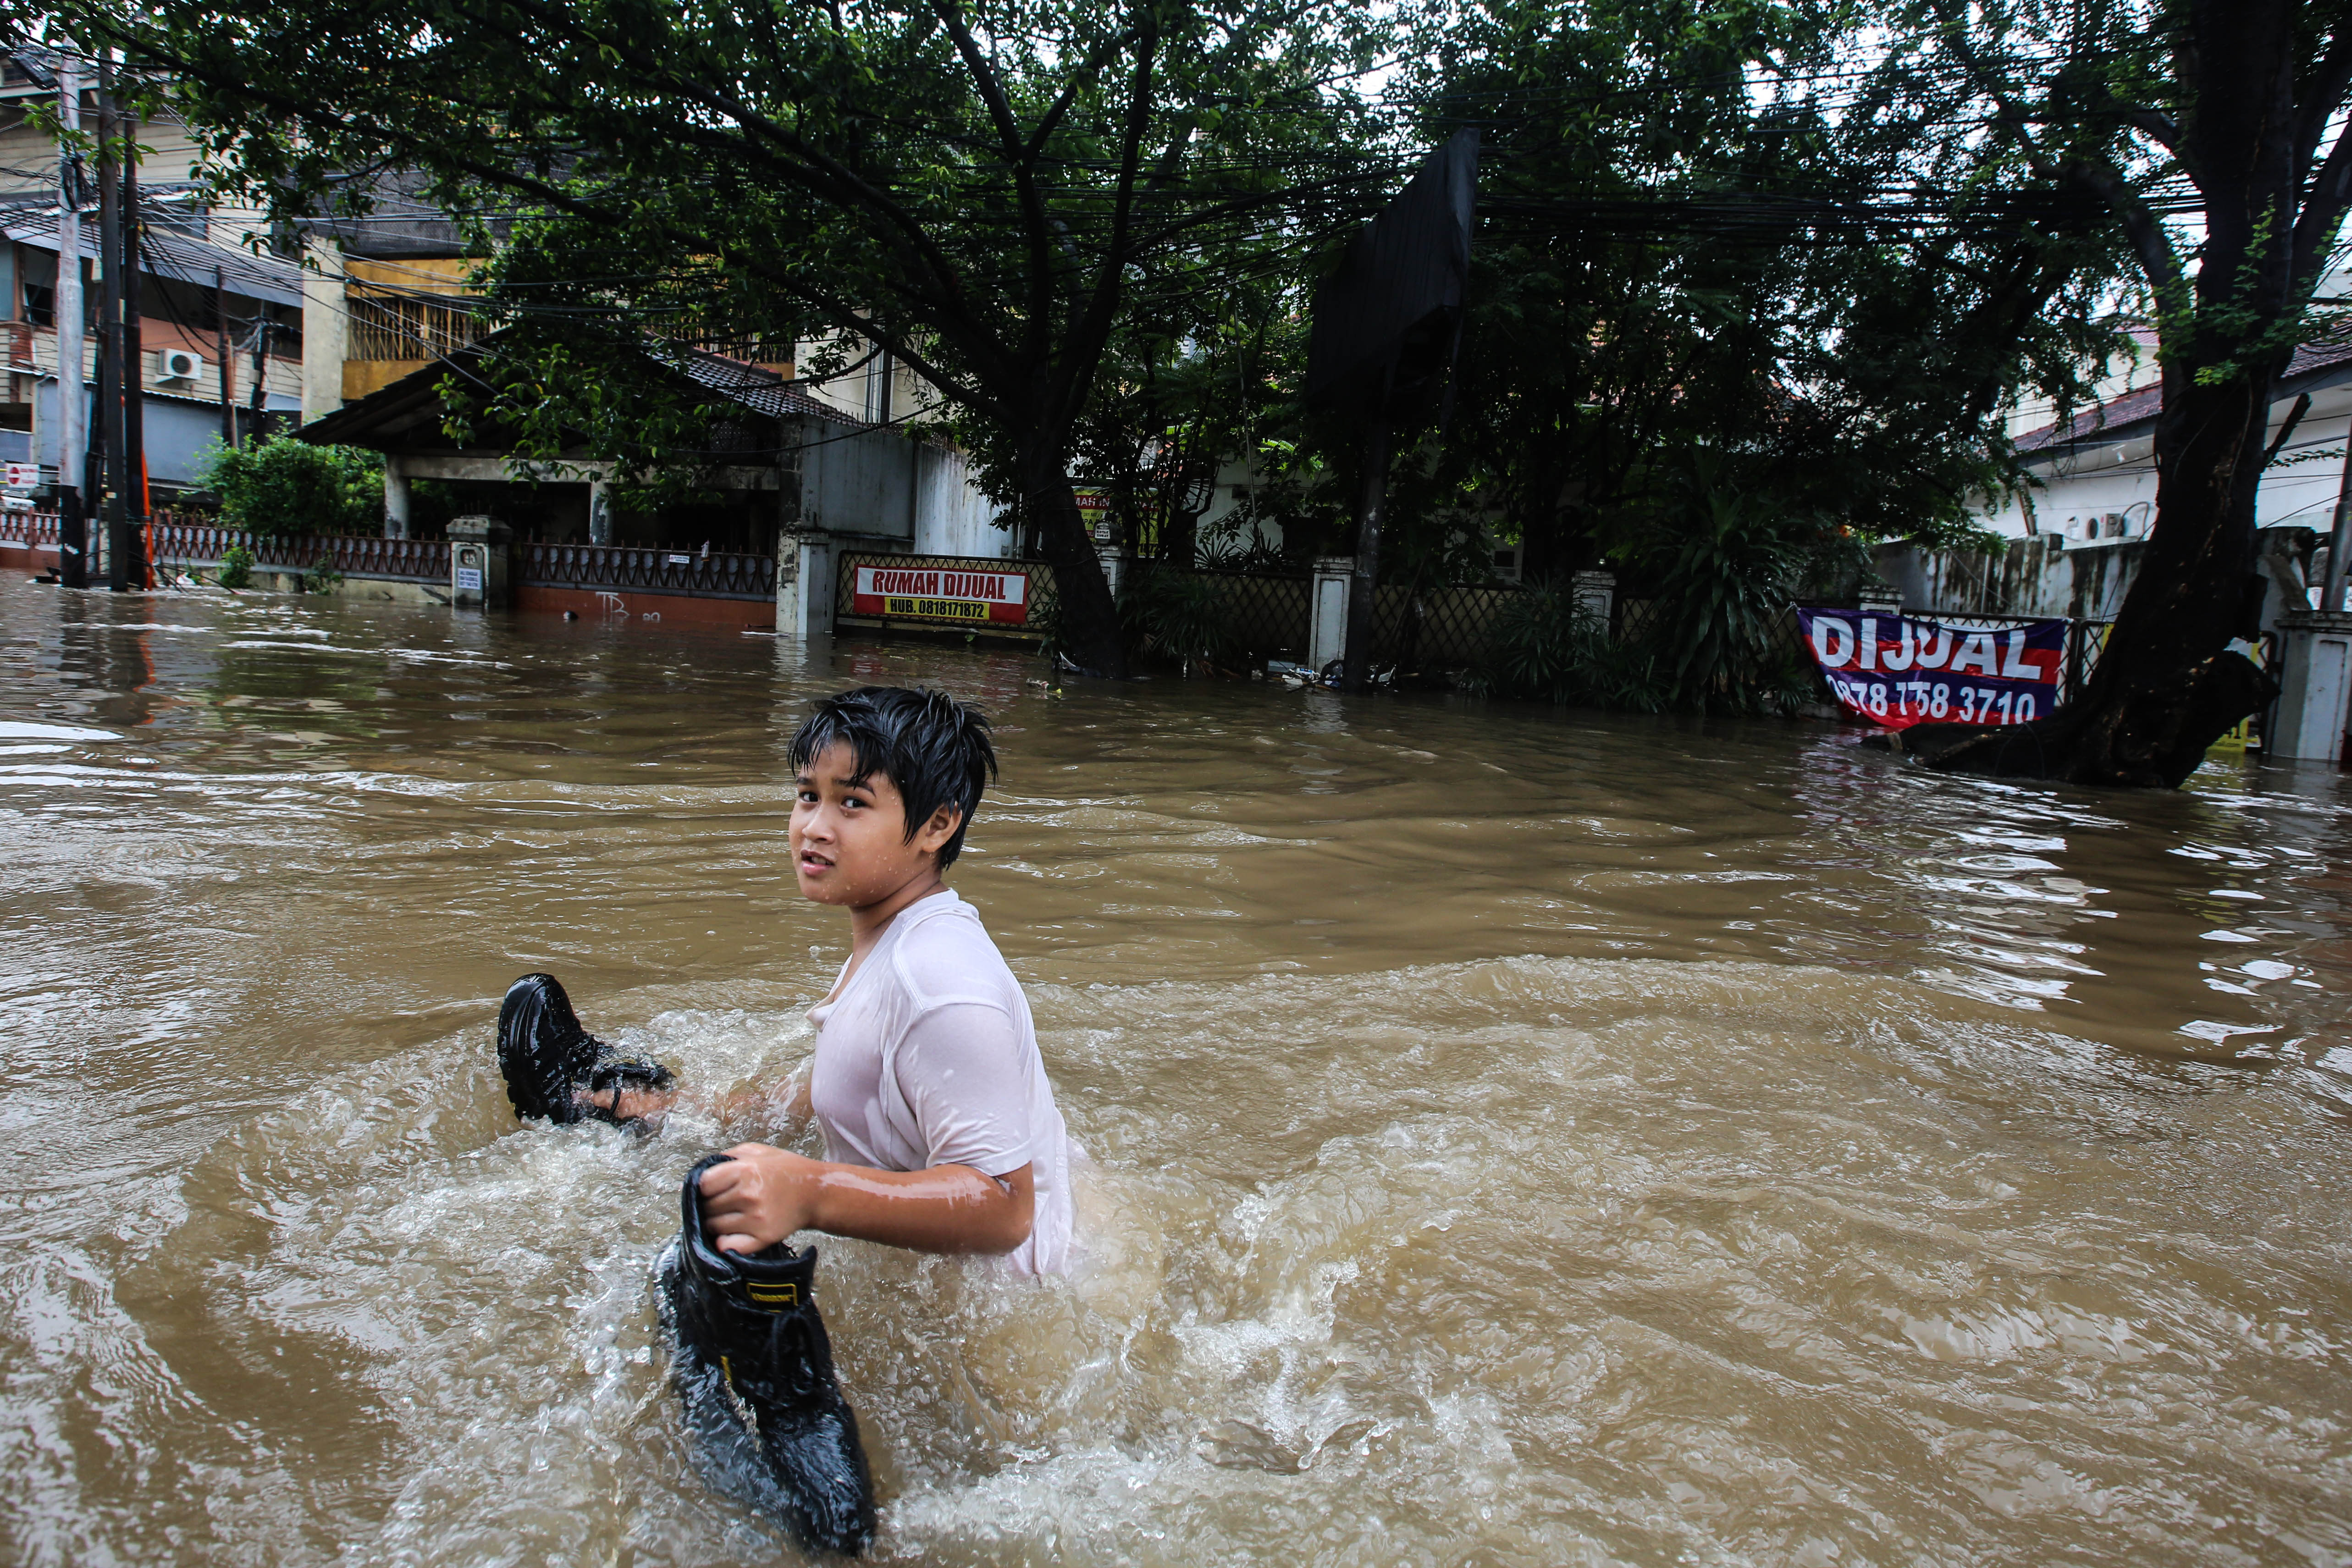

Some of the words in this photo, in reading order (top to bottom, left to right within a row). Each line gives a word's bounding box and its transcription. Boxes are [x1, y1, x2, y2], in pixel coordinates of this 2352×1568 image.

[872, 571, 939, 595] RUMAH
[944, 574, 1006, 600] DIJUAL
[890, 598, 916, 613] HUB.
[918, 600, 984, 618] 0818171872
[1812, 616, 2042, 680] DIJUAL
[1825, 674, 1888, 717] 0878
[1959, 686, 2035, 725] 3710
